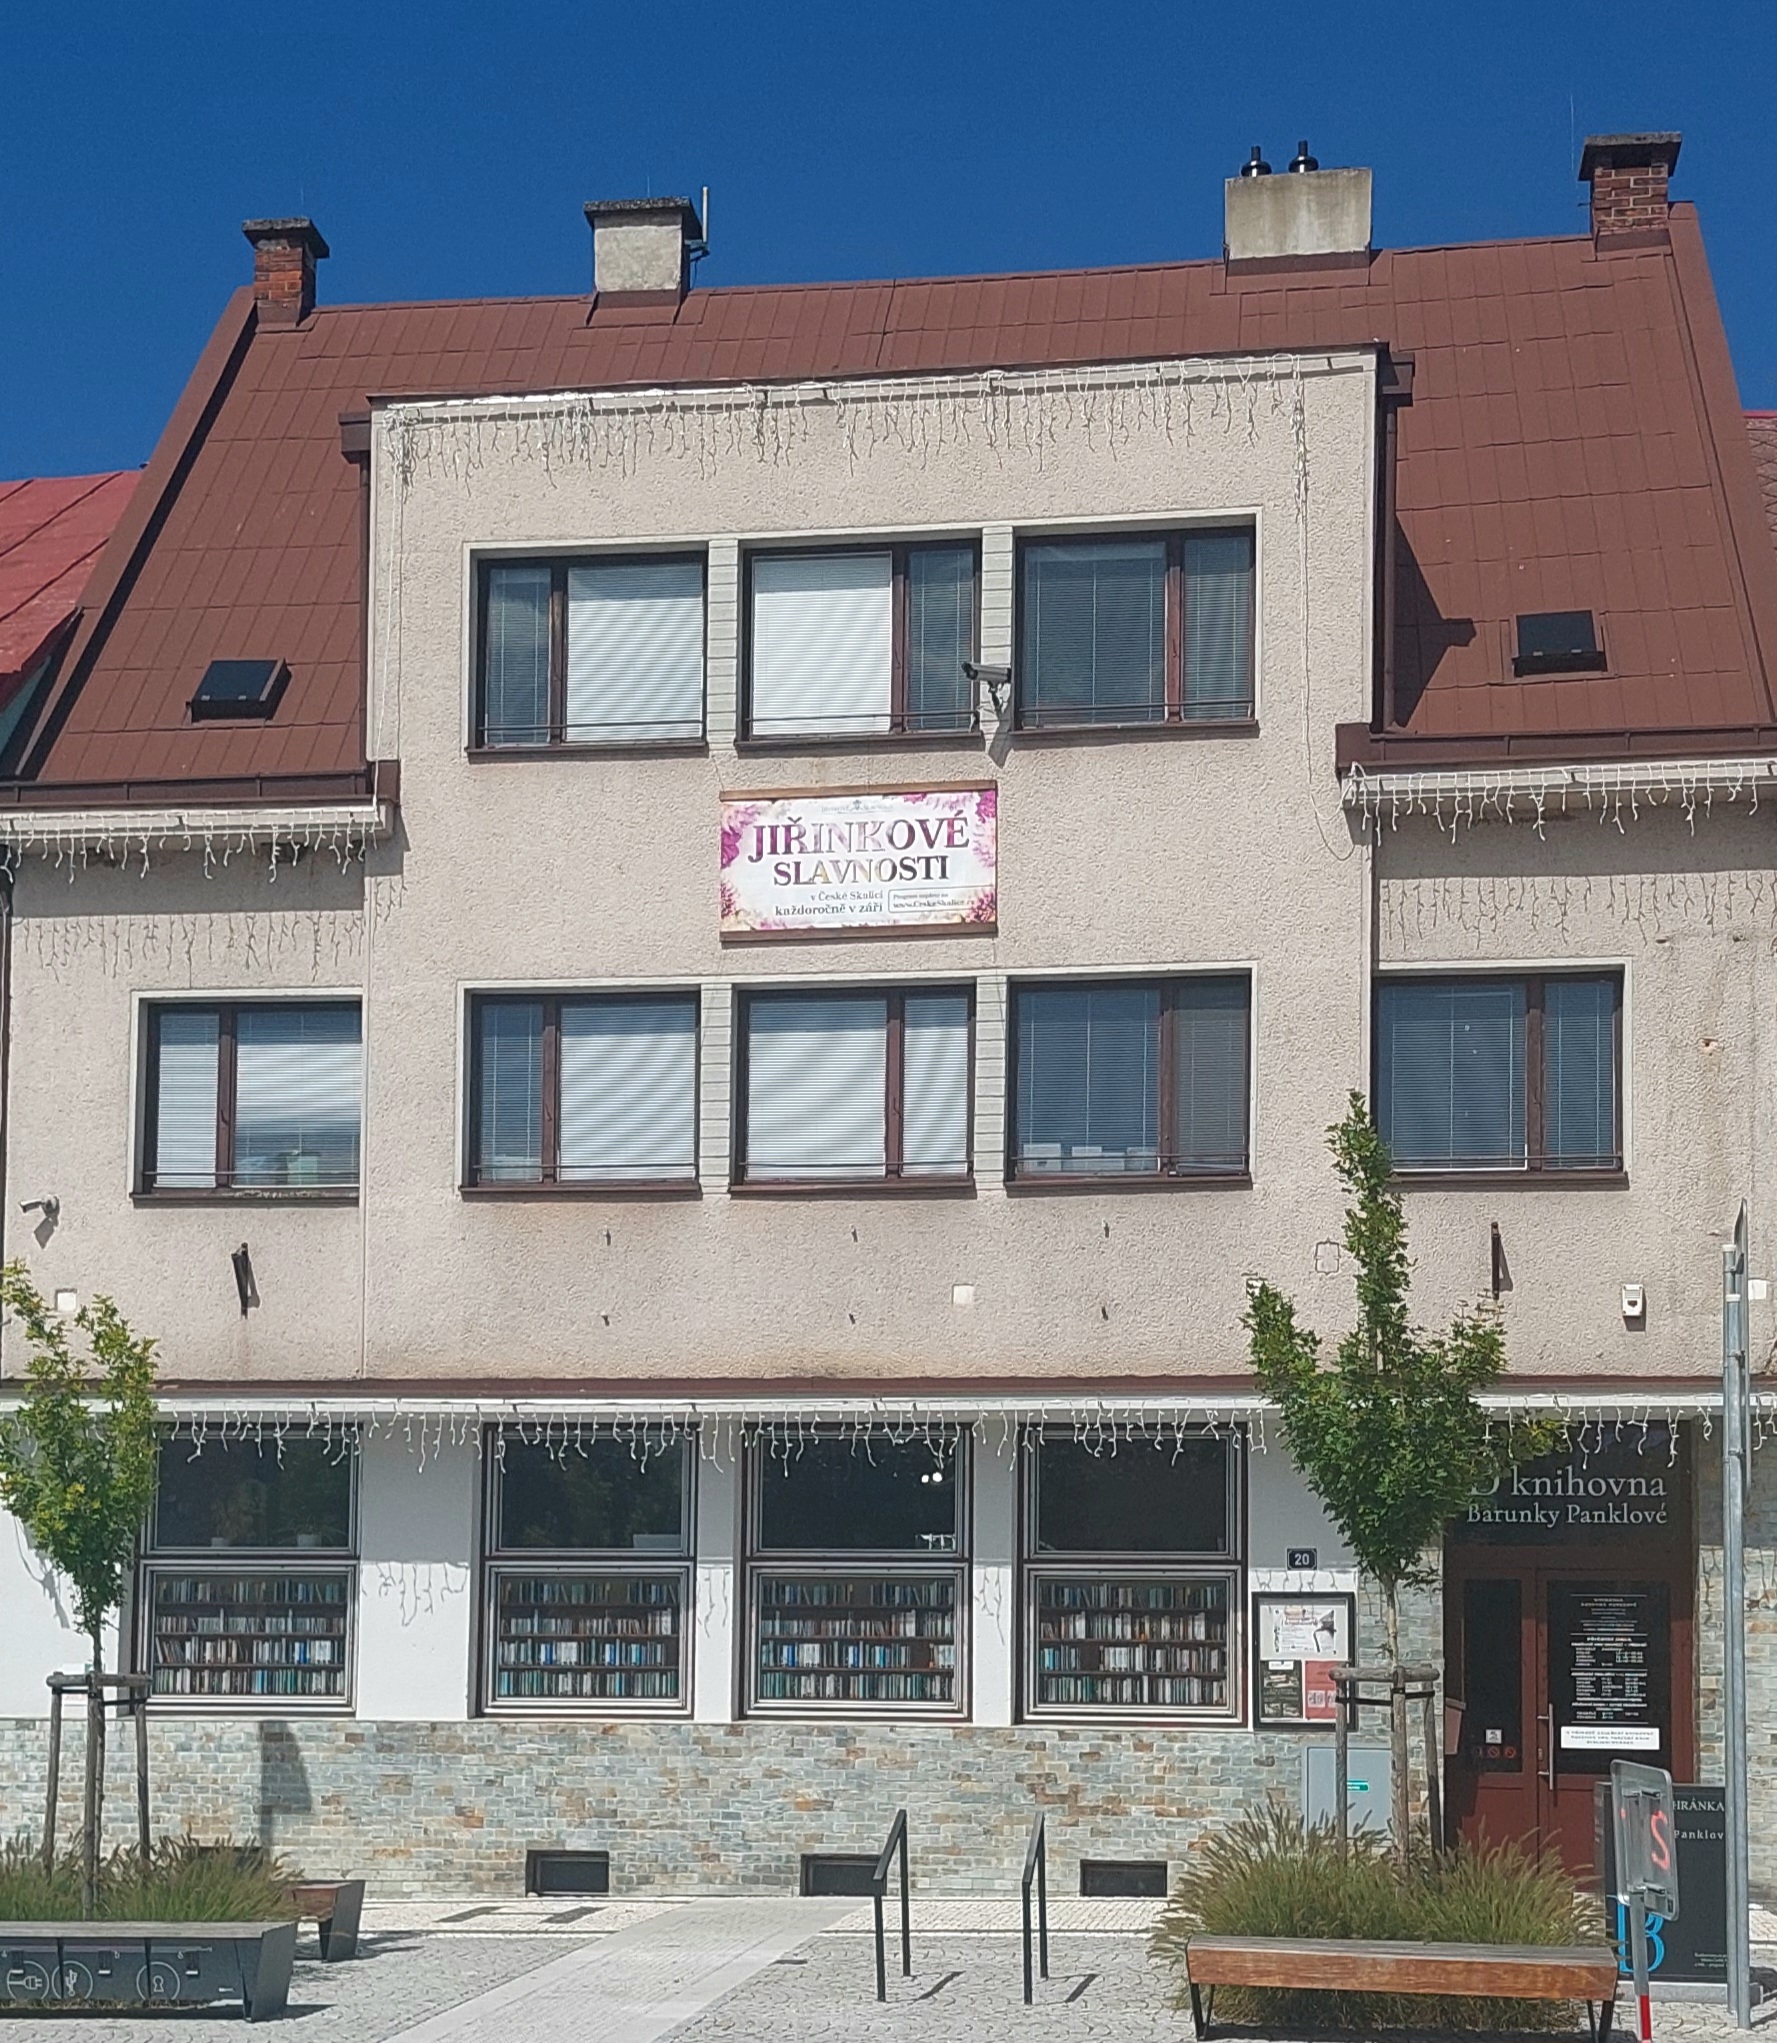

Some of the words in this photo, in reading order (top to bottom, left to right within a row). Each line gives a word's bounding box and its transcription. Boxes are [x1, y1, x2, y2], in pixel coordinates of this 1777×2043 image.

[748, 810, 970, 864] JIŘINKOVÉ
[774, 855, 949, 886] SLAVNOSTI
[775, 902, 846, 916] každoročně
[849, 905, 857, 913] v
[858, 902, 883, 913] září
[1511, 1464, 1667, 1497] knihovna
[1467, 1502, 1560, 1528] Barunky
[1566, 1501, 1667, 1524] Panklové
[1294, 1553, 1310, 1566] 20
[1673, 1796, 1725, 1812] HRÁNKA
[1674, 1829, 1724, 1840] Panklov
